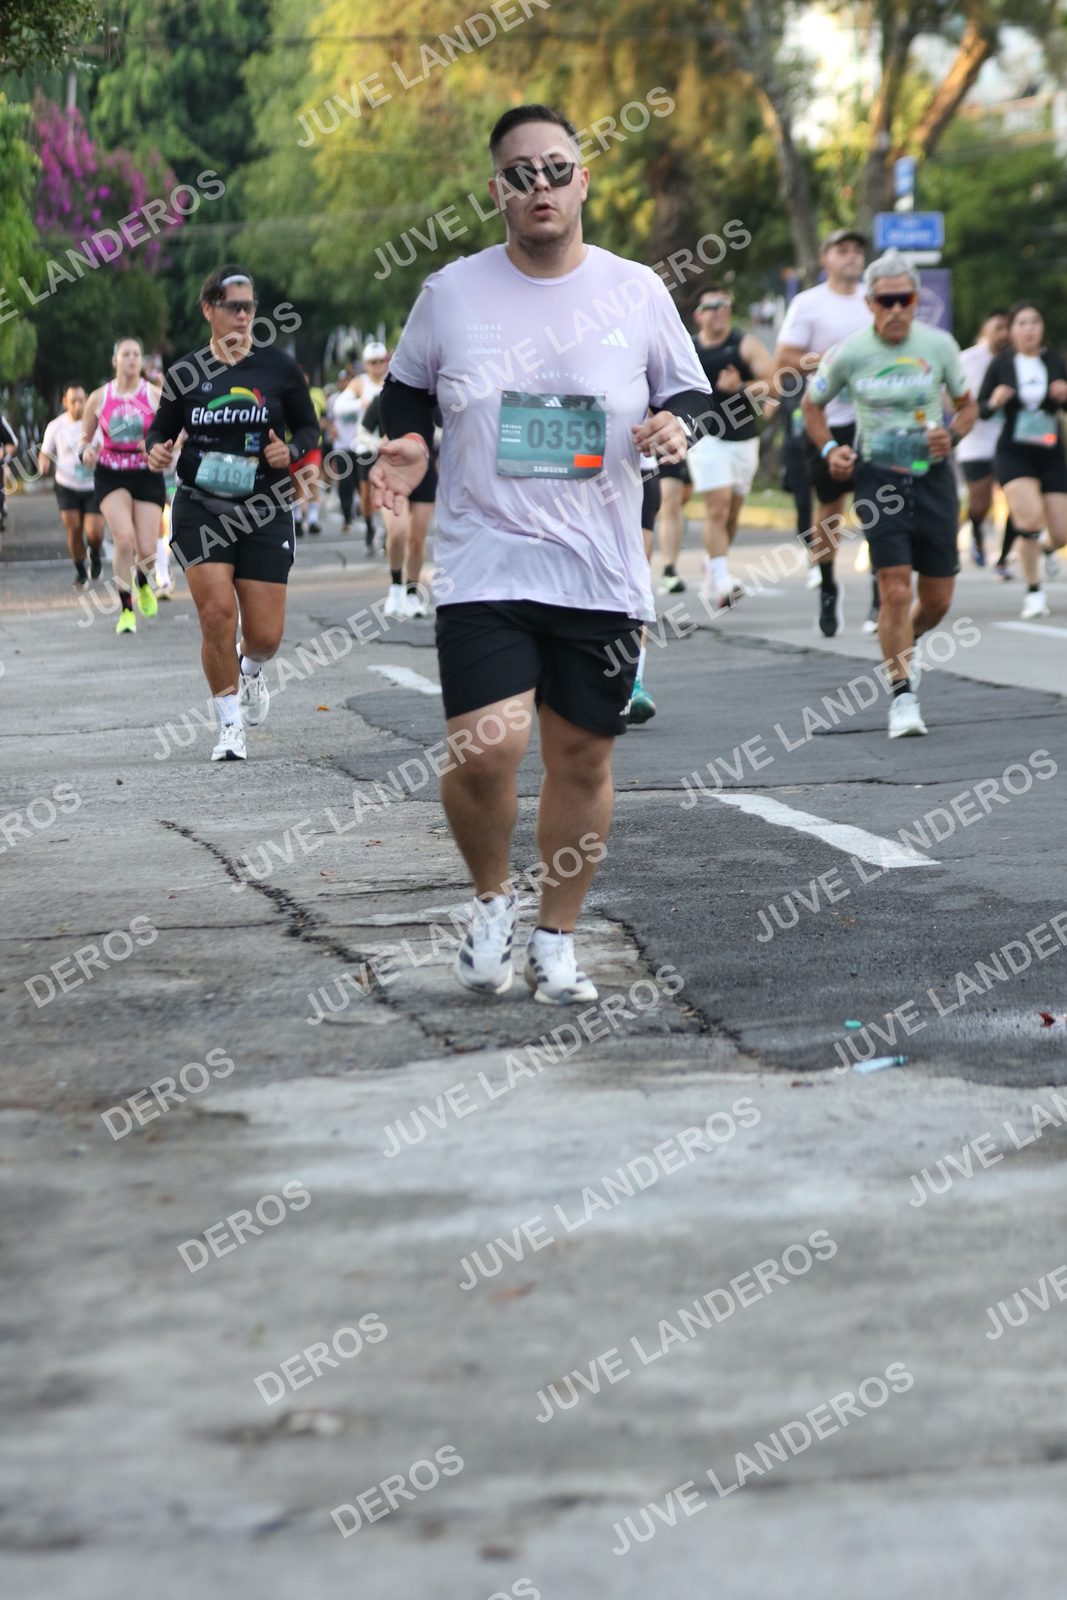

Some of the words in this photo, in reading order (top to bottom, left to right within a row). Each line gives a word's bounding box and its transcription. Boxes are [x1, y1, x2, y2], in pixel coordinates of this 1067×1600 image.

[191, 406, 269, 425] Electrolit
[527, 418, 600, 451] 0359
[533, 465, 568, 474] SAMSUNG
